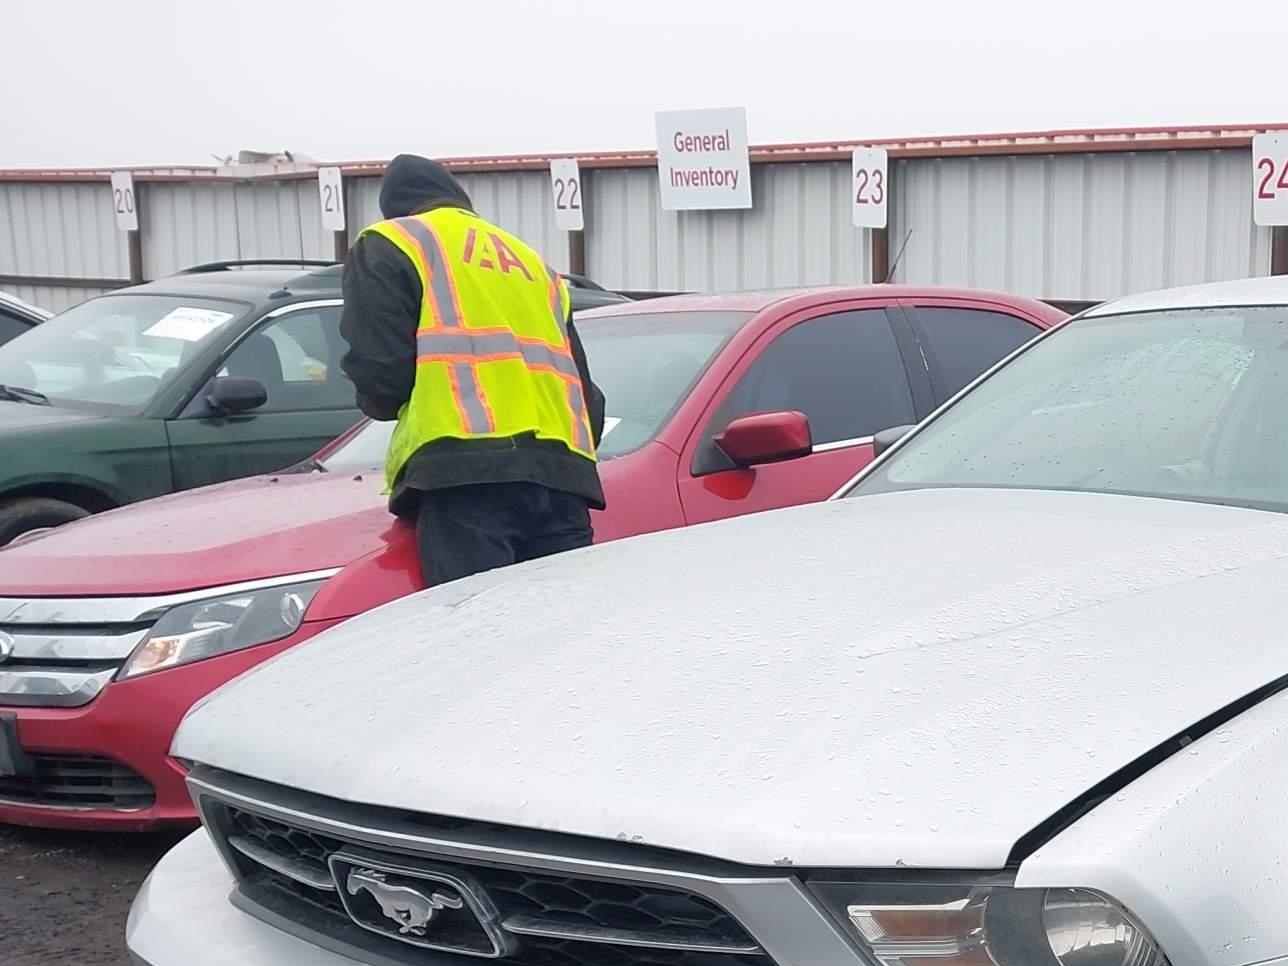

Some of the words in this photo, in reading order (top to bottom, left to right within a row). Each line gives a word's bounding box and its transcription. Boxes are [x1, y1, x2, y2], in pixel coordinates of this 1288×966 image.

[673, 129, 730, 152] General
[669, 166, 739, 190] Inventory
[855, 168, 884, 205] 23
[114, 188, 134, 214] 20
[322, 184, 342, 213] 21
[554, 178, 581, 210] 22
[463, 227, 535, 282] IAA
